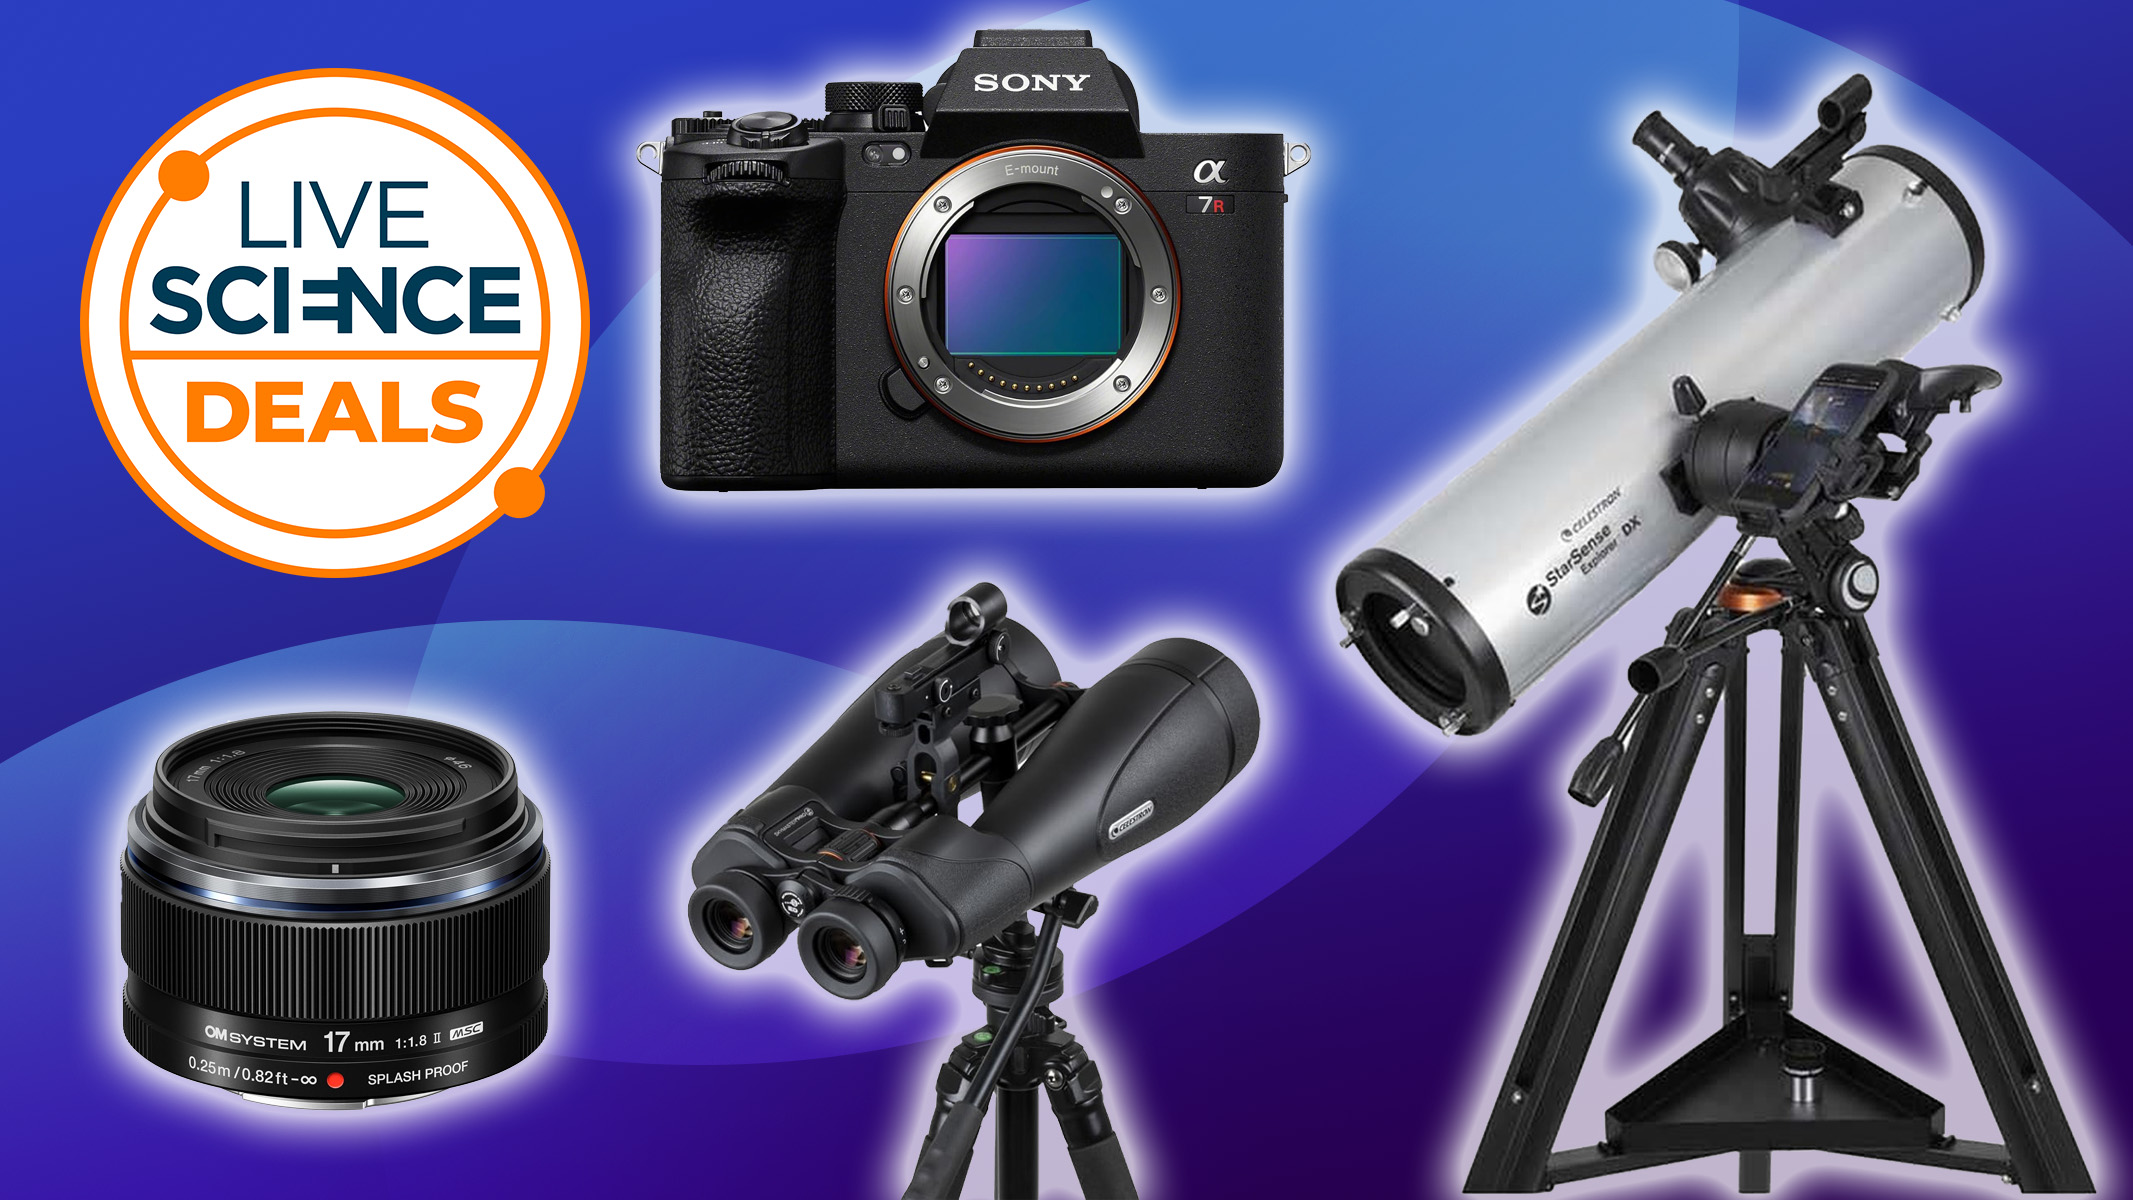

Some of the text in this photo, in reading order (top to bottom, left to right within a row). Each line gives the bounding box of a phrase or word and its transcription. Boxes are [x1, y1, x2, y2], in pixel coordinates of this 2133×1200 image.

[974, 73, 1091, 92] SONY
[1004, 162, 1060, 177] E-mount
[1198, 195, 1225, 213] 7R
[1572, 487, 1622, 534] CELESTRON
[1545, 524, 1612, 588] StarSense
[1579, 514, 1642, 576] Explorer DX
[210, 749, 246, 763] 1:1.8
[323, 1031, 351, 1053] 17
[354, 1039, 385, 1052] mm
[395, 1035, 427, 1050] 1:1.8
[451, 1022, 483, 1040] MSC
[367, 1070, 421, 1086] SPLASH
[425, 1060, 469, 1080] PROOF
